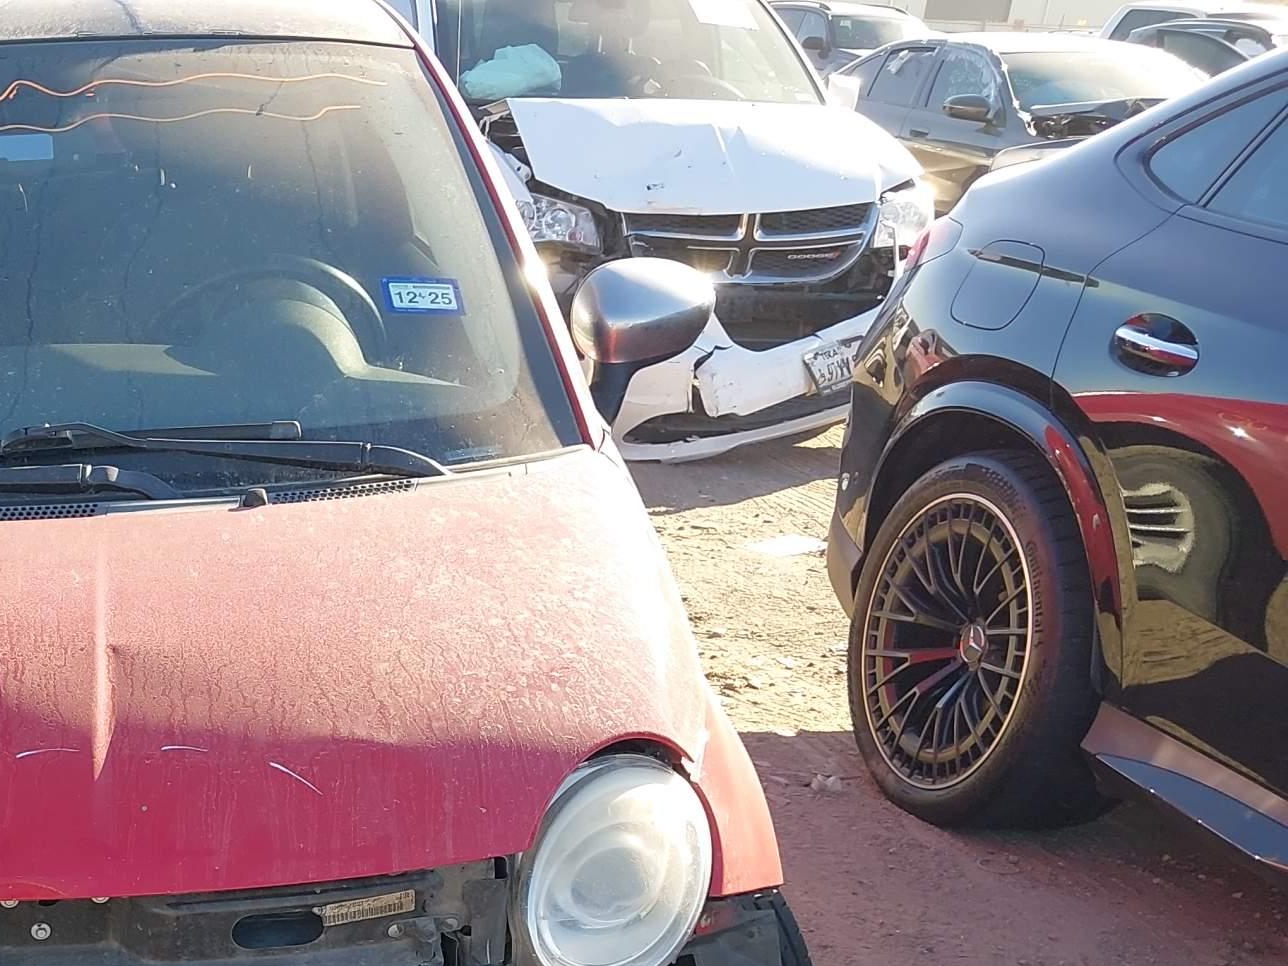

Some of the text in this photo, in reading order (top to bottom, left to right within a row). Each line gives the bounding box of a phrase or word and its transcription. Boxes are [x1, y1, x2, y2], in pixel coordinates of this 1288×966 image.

[394, 291, 452, 306] 12 25
[1025, 540, 1044, 634] Continental
